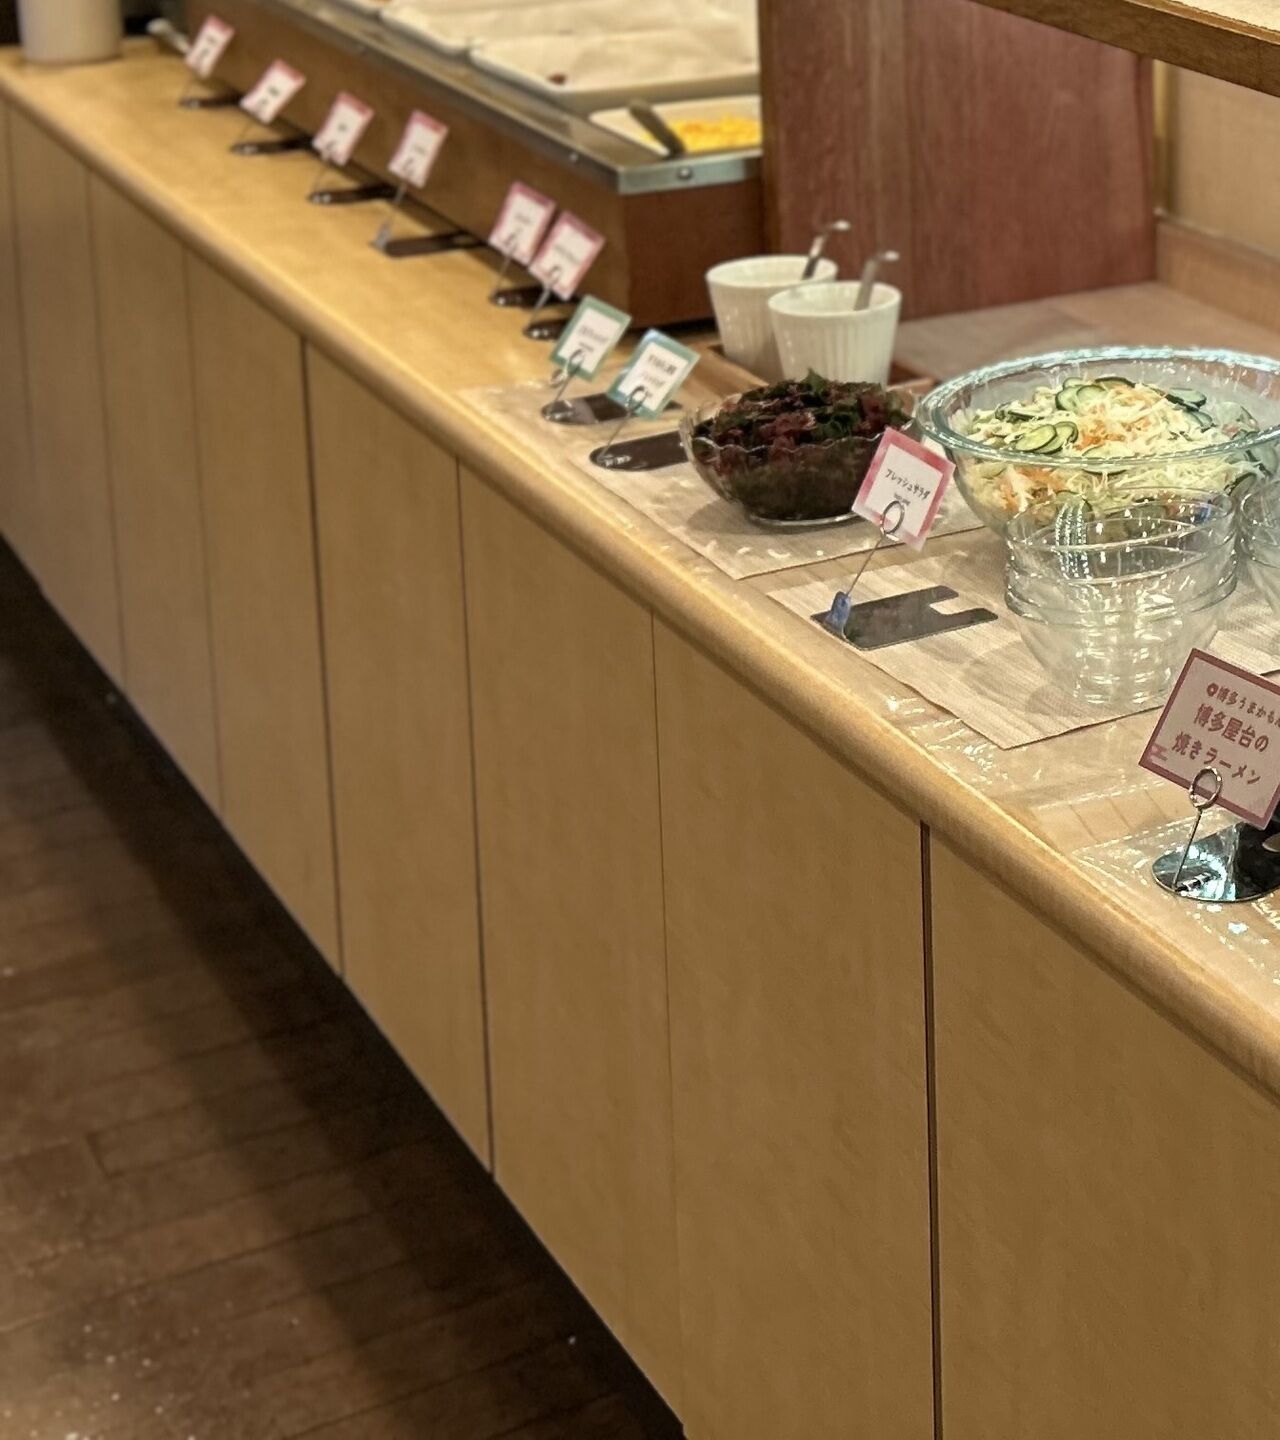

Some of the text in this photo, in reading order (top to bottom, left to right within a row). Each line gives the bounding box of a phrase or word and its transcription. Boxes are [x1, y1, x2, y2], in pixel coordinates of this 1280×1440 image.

[885, 468, 931, 500] フレッシュサラダ
[1193, 703, 1270, 753] 博多屋台の
[1171, 730, 1262, 785] 焼きラーメン
